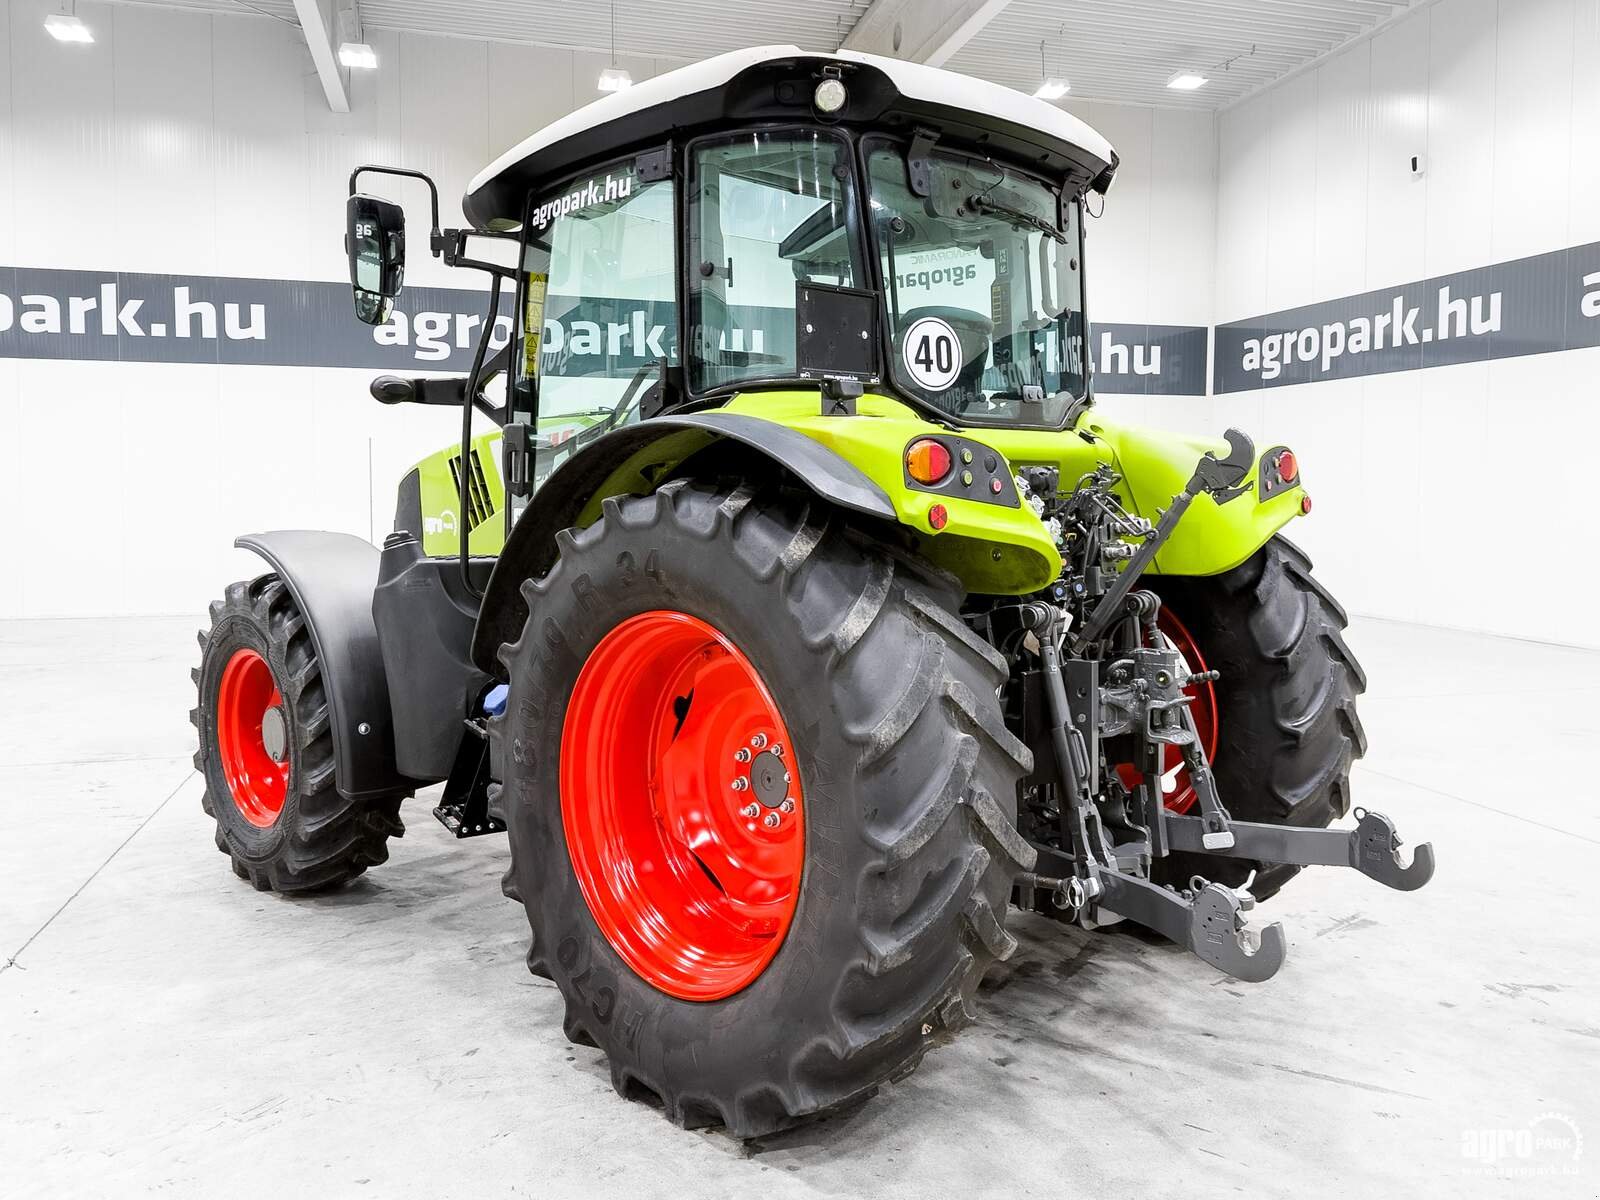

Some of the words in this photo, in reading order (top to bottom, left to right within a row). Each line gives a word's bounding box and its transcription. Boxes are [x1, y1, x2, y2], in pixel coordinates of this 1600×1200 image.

[532, 175, 632, 230] agropark.hu
[372, 307, 765, 361] agropark.u
[914, 335, 953, 374] 40
[1241, 285, 1502, 380] agropark.hu
